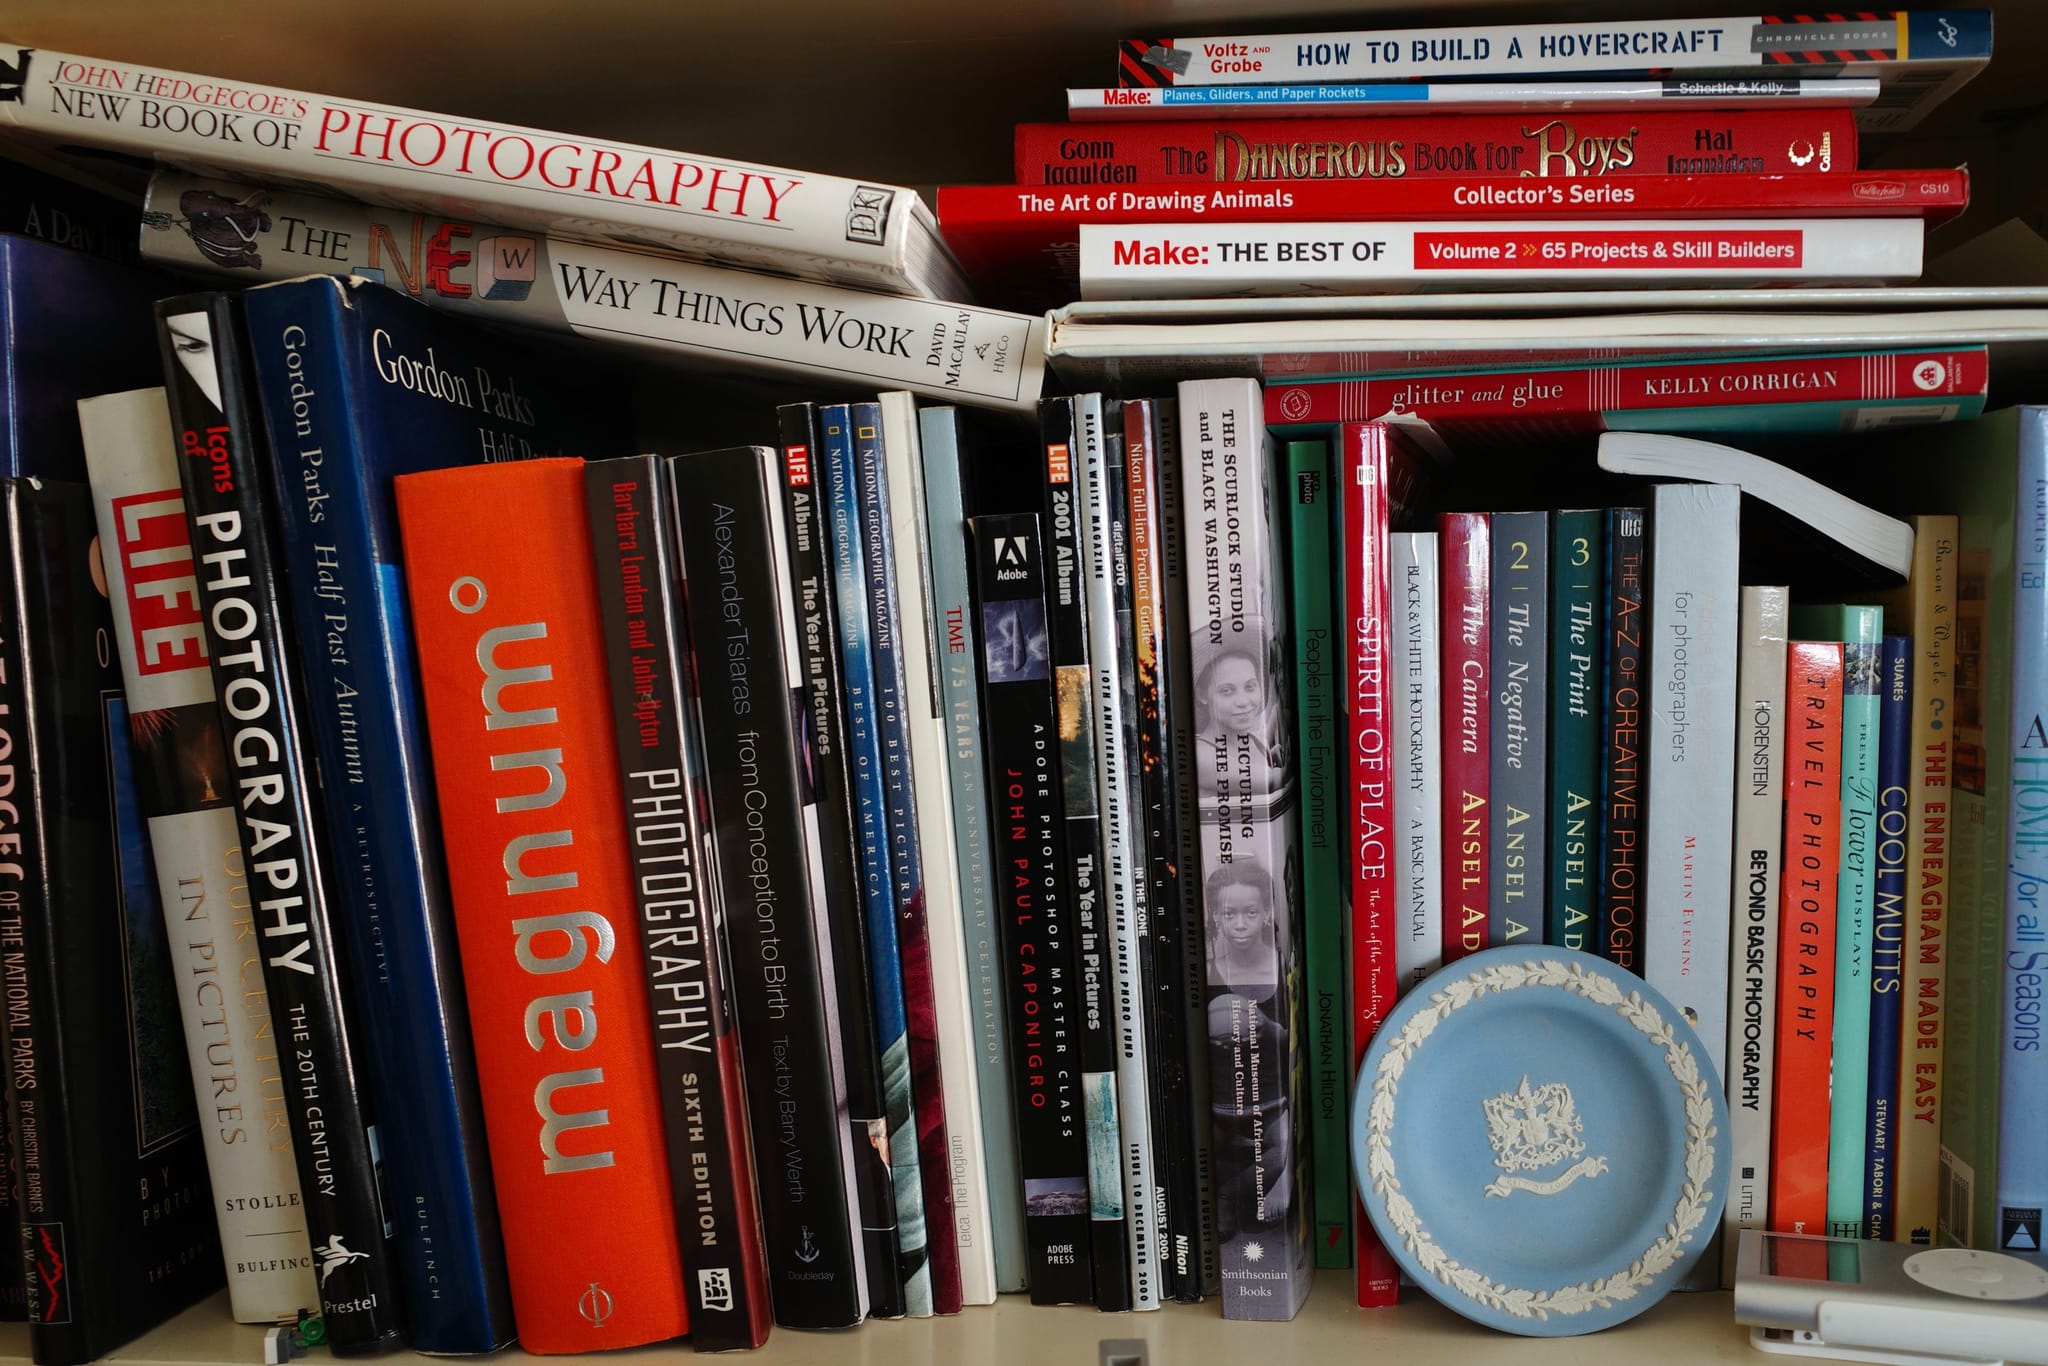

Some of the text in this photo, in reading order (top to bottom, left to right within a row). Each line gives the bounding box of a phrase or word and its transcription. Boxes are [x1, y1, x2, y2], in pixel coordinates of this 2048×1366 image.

[1203, 43, 1248, 58] Voltz
[1210, 57, 1263, 75] Grobe
[1297, 29, 1723, 66] HOW TO BUILD A HOVERCRAFT
[1756, 31, 1888, 44] CHRONICLE BOOKS
[49, 60, 309, 119] JOHN HEDGECOE'S
[50, 86, 302, 151] NEW BOOK OF
[1103, 86, 1367, 105] Make: Planes, Gliders, and Paper Rockets
[313, 106, 802, 222] PHOTOGRAPHY
[1160, 120, 1640, 182] The DANGEROUS Book for Boys
[1694, 128, 1733, 151] Hal
[1018, 188, 1294, 214] The Art of Drawing Animals
[1454, 183, 1635, 205] Collector's Series
[1920, 182, 1950, 194] CS10
[280, 217, 916, 359] THE WAY THINGS WORK
[1113, 239, 1386, 267] Make: THE BEST OF
[1429, 240, 1794, 263] Volume 2 65 Projects & Skill Builders
[926, 321, 947, 368] DAVID
[945, 310, 973, 387] MACAULAY
[1645, 371, 1838, 395] KELLY CORRIGAN
[183, 430, 207, 456] of
[1392, 378, 1563, 412] glitter and glue
[206, 426, 235, 493] Icons
[283, 325, 364, 785] Gordon Parks Half Past Autumn
[863, 449, 889, 650] NATIONAL GEOGRAPHIC MAGAZINE
[1049, 446, 1072, 605] LIFE 2001 Album
[1131, 443, 1150, 644] Nikon Full-line Product Guide
[1199, 411, 1222, 646] and BLACK WASHINGTON
[1222, 409, 1244, 633] THE SCURLOCK STUDIO
[121, 497, 209, 666] LIFE
[788, 447, 830, 755] LIFE Album The Year in Pictures
[997, 569, 1027, 581] Adobe
[947, 605, 965, 654] TIME
[1356, 616, 1383, 724] SPIRIT
[1668, 591, 1694, 762] for photographers
[712, 503, 789, 1020] Alexander Tsiaras from Conception to Birth
[1237, 734, 1253, 839] PICTURING
[1358, 729, 1384, 778] OF
[1462, 660, 1486, 890] Camera ANSEL
[1501, 603, 1531, 903] The Negative ANSEL
[1566, 602, 1592, 890] The Print ANSEL
[1216, 735, 1232, 865] THE PROMISE
[1360, 784, 1385, 880] PLACE
[196, 510, 336, 1197] PHOTOGRAPHY THE 20TH CENTURY
[1797, 677, 1826, 1041] TRAVEL PHOTOGRAPHY
[1873, 786, 1907, 993] COOL MUTTS
[1008, 769, 1045, 1107] JOHN PAUL CAPONIGRO
[1682, 835, 1697, 976] MARTIN EVENING
[1915, 742, 1947, 1125] THE ENNEAGRAM MADE EASY
[178, 876, 247, 1145] IN PICTURES
[629, 769, 716, 1246] PHOTOGRAPHY SIXTH EDITION
[1742, 850, 1768, 1111] BEYOND BASIC PHOTOGRAPHY
[2006, 914, 2048, 1051] all Seasons
[1320, 990, 1336, 1120] JONATHAN HILTON
[416, 1196, 441, 1300] BULFINCH
[1047, 1244, 1073, 1254] ADOBE
[1048, 1255, 1074, 1264] PRESS
[1155, 1186, 1169, 1260] AUGUST 2000
[1175, 1234, 1188, 1275] Nikon
[324, 1293, 377, 1315] Prestel
[1222, 1269, 1288, 1280] Smithsonian
[1240, 1286, 1272, 1297] Books
